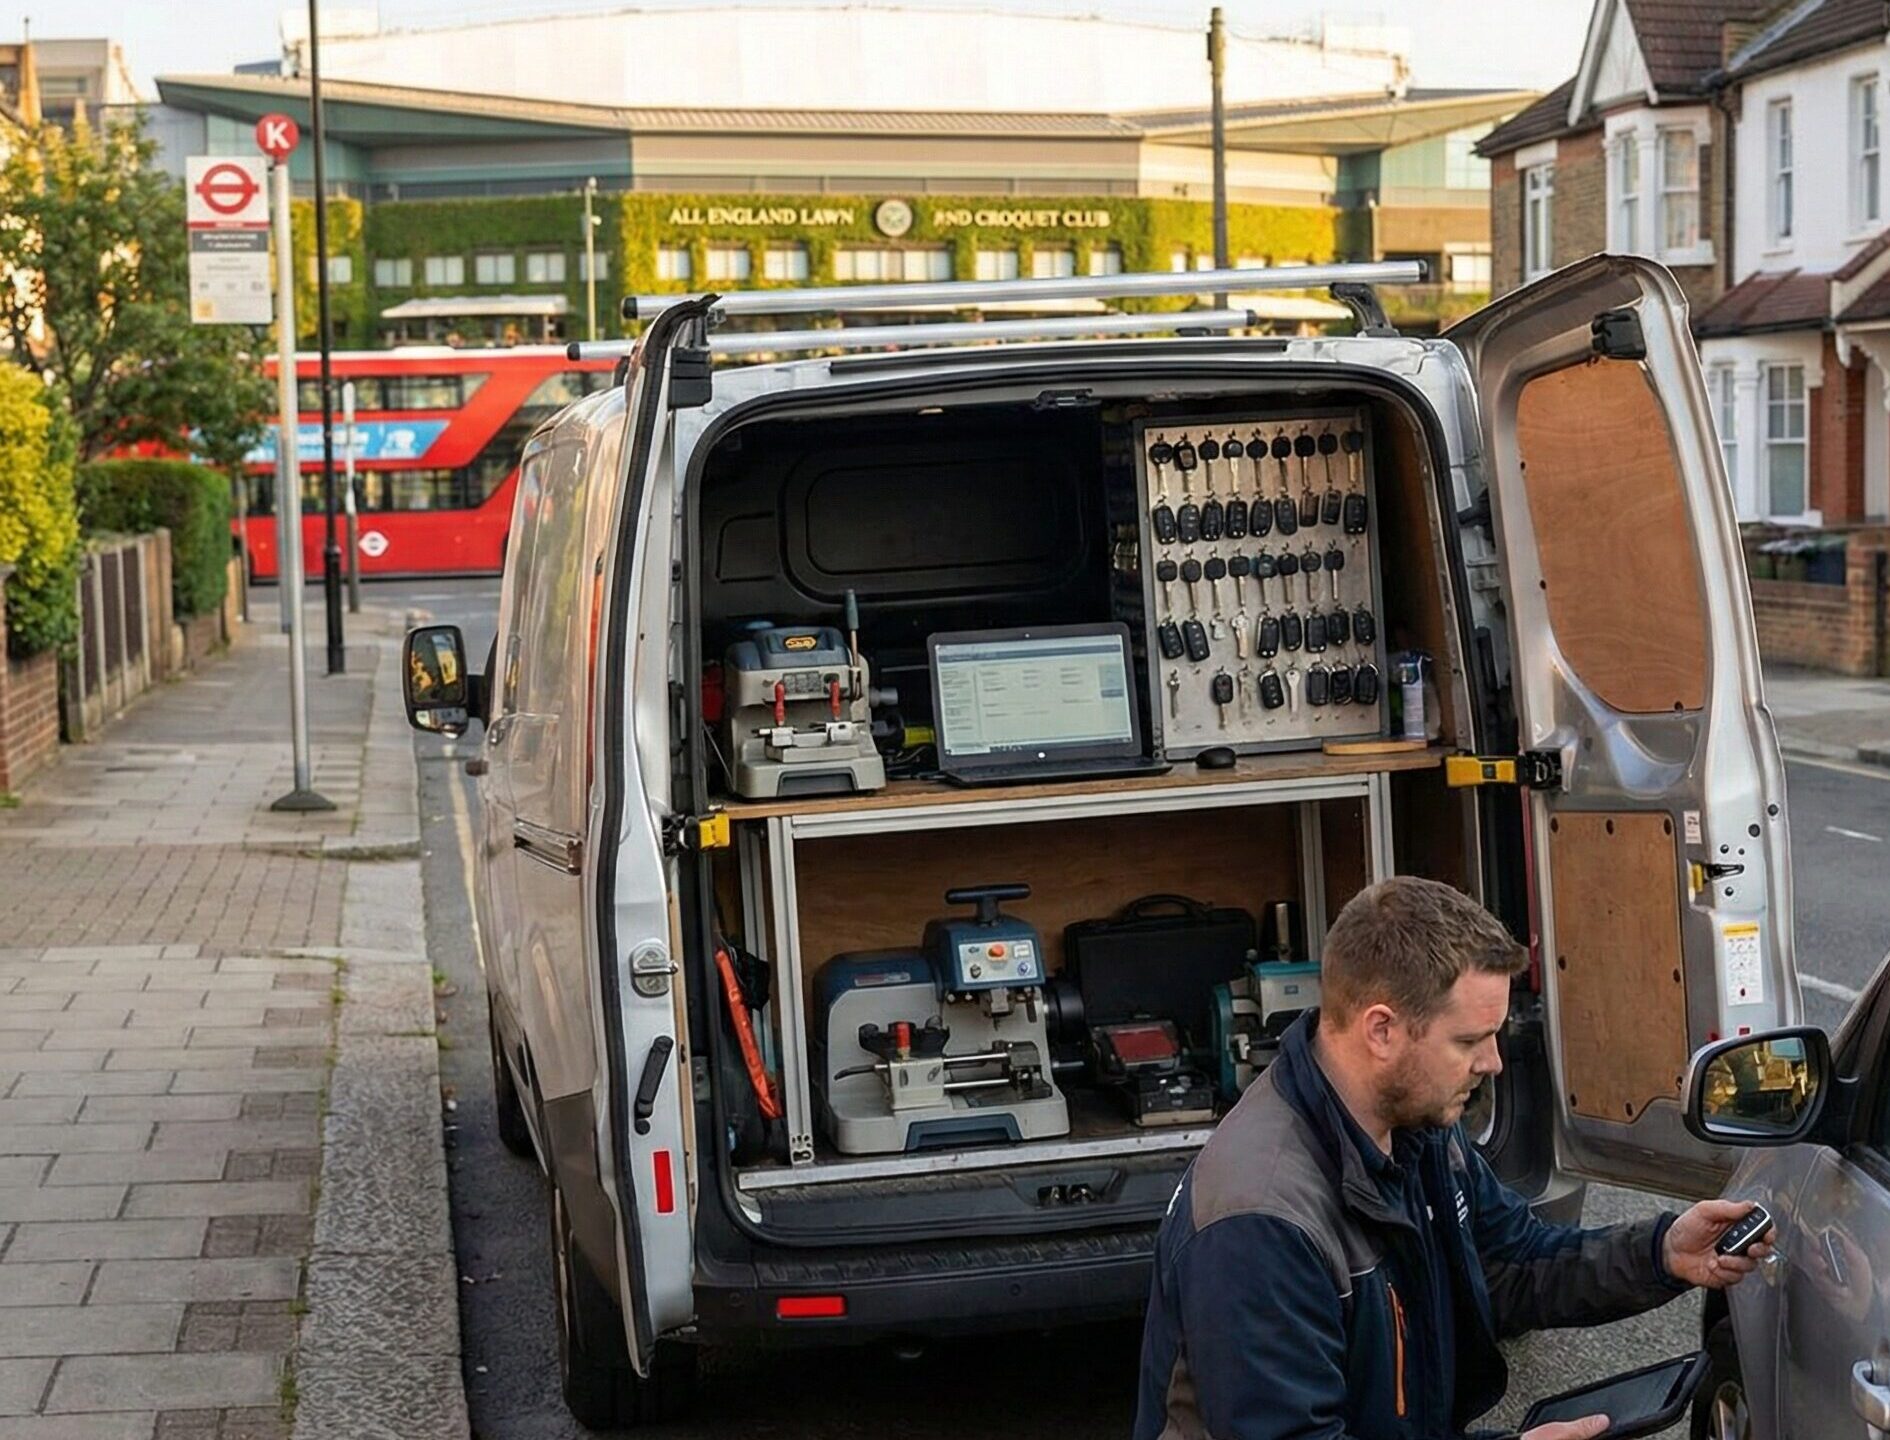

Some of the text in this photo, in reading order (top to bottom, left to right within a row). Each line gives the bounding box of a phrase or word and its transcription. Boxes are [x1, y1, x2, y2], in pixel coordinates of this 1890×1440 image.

[266, 121, 291, 149] K
[669, 207, 705, 225] ALL
[707, 207, 797, 225] ENGLAND
[801, 208, 854, 225] LAWN
[974, 209, 1060, 229] CROQUET
[1062, 209, 1111, 228] CLUB
